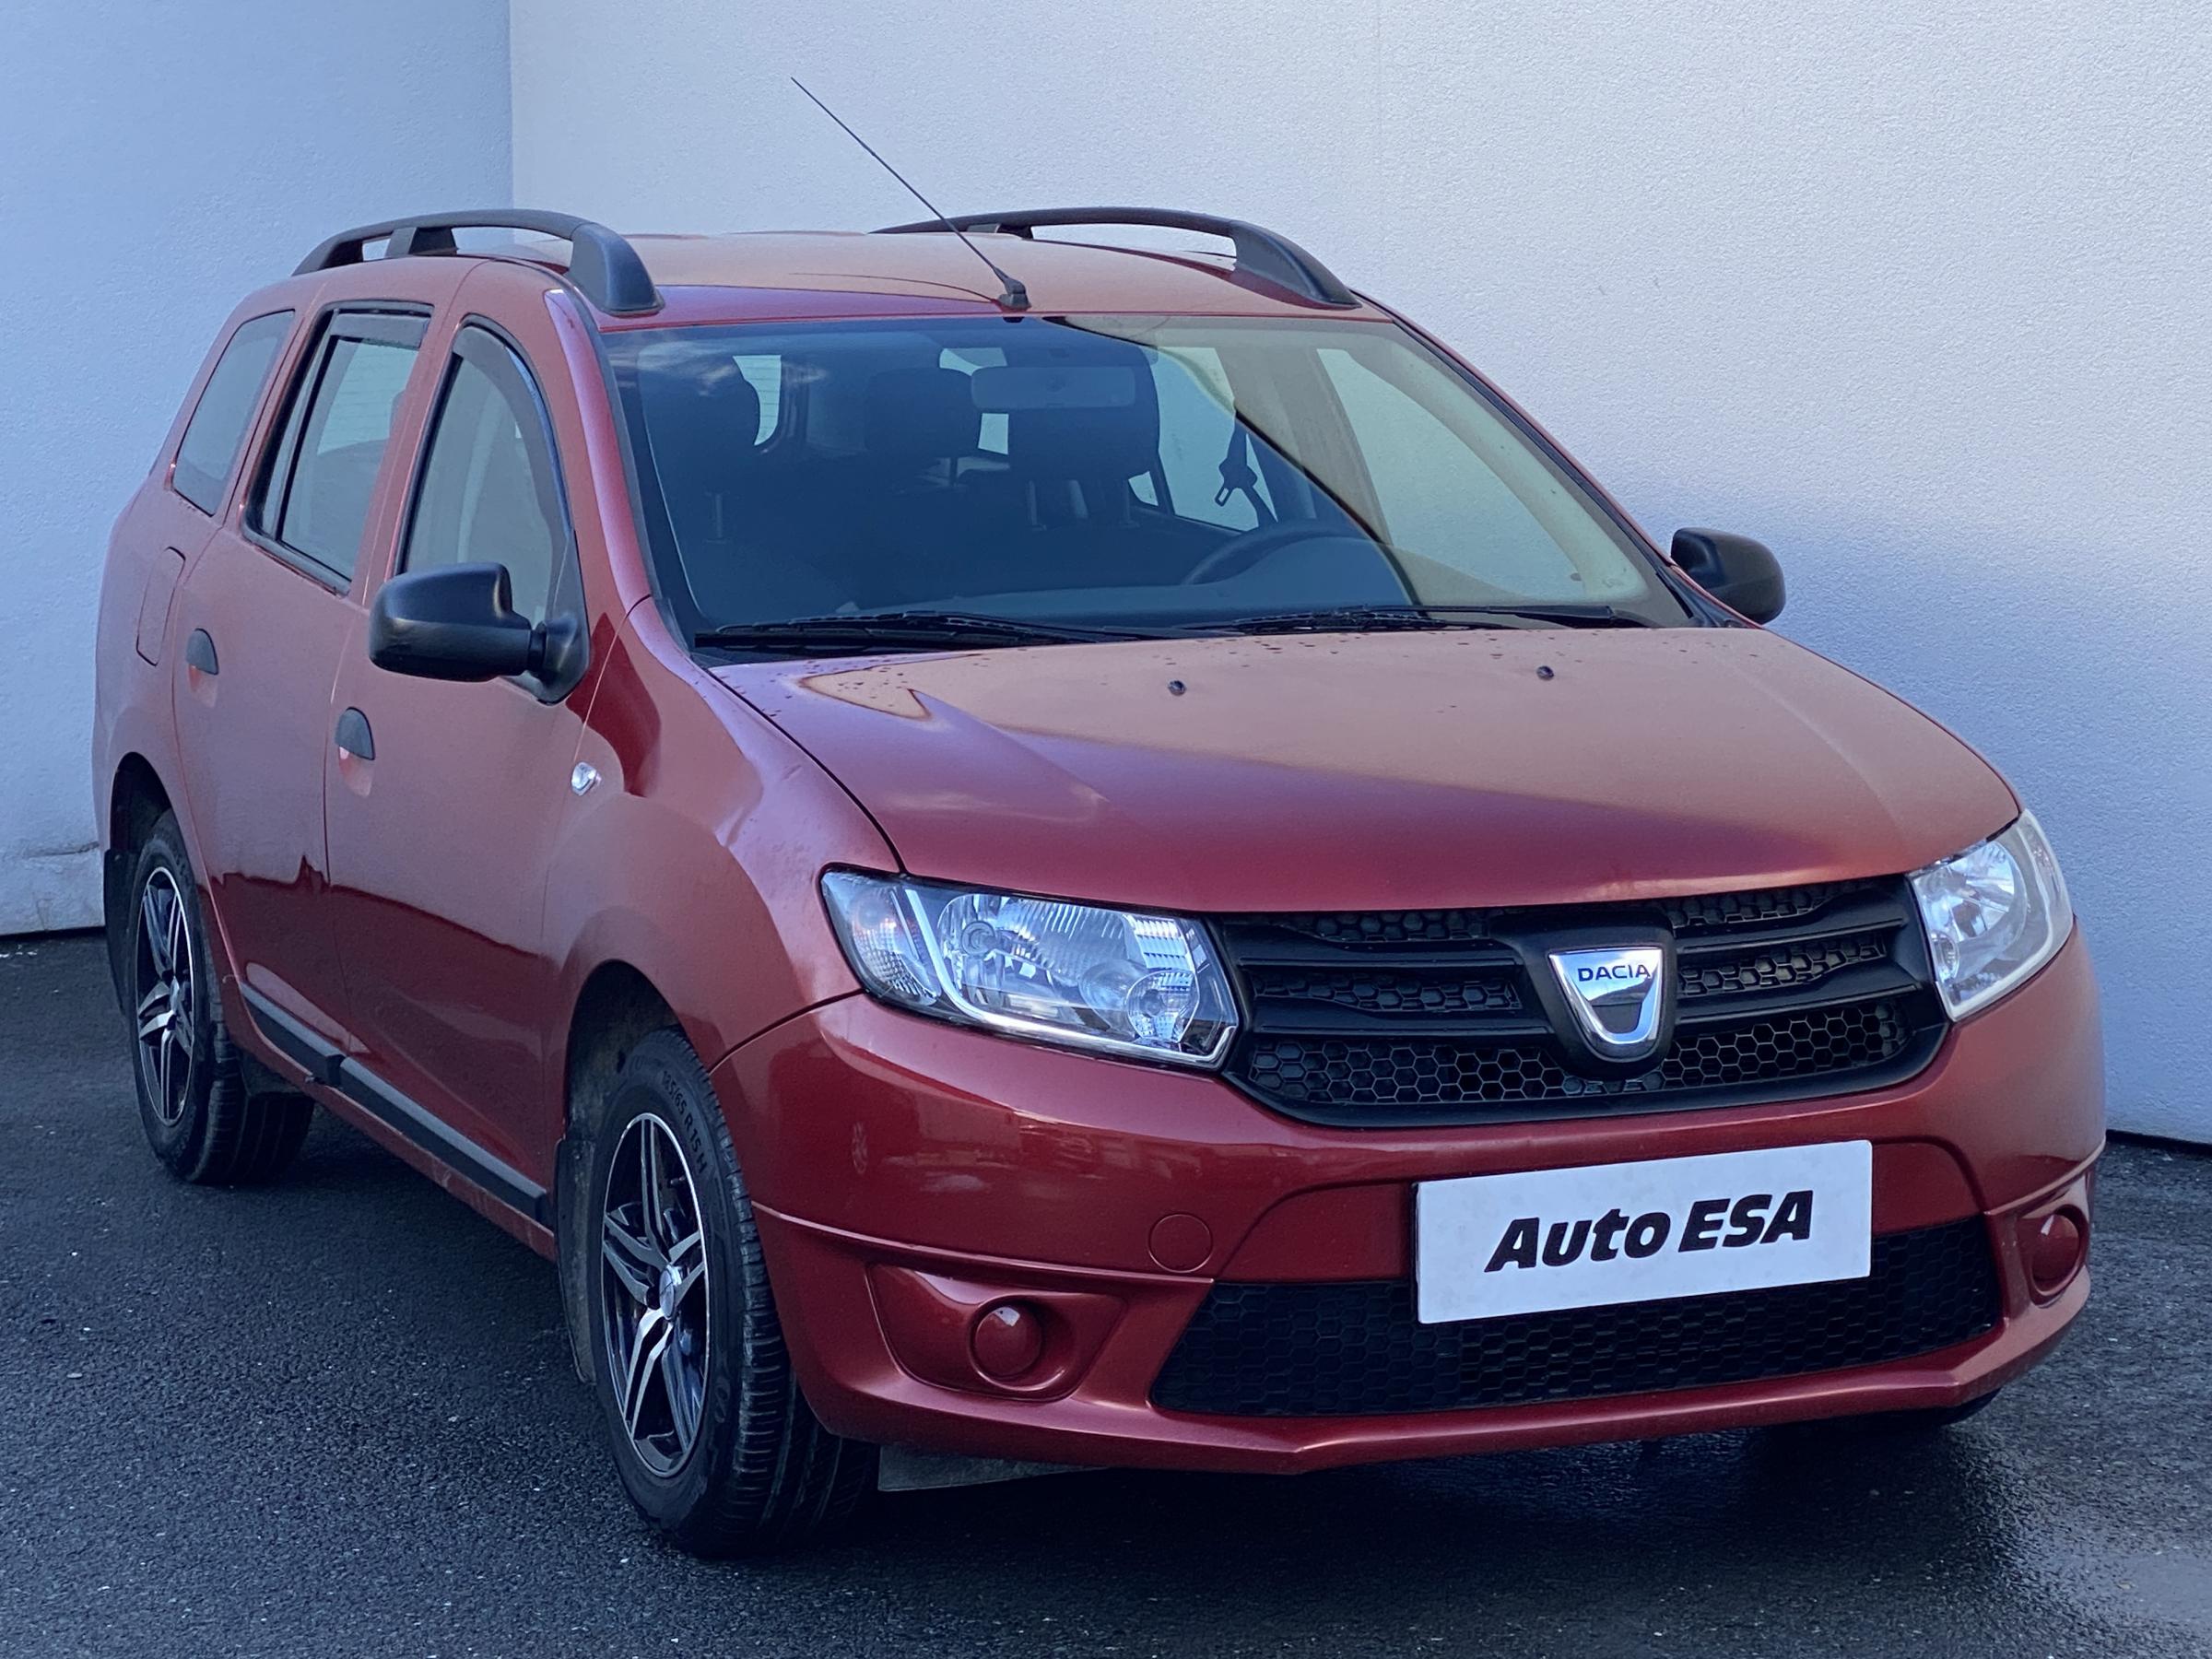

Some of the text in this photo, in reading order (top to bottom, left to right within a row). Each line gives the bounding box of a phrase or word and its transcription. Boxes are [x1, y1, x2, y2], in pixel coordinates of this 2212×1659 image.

[1577, 964, 1652, 982] DACIA
[1483, 1189, 1814, 1273] Auto ESA
